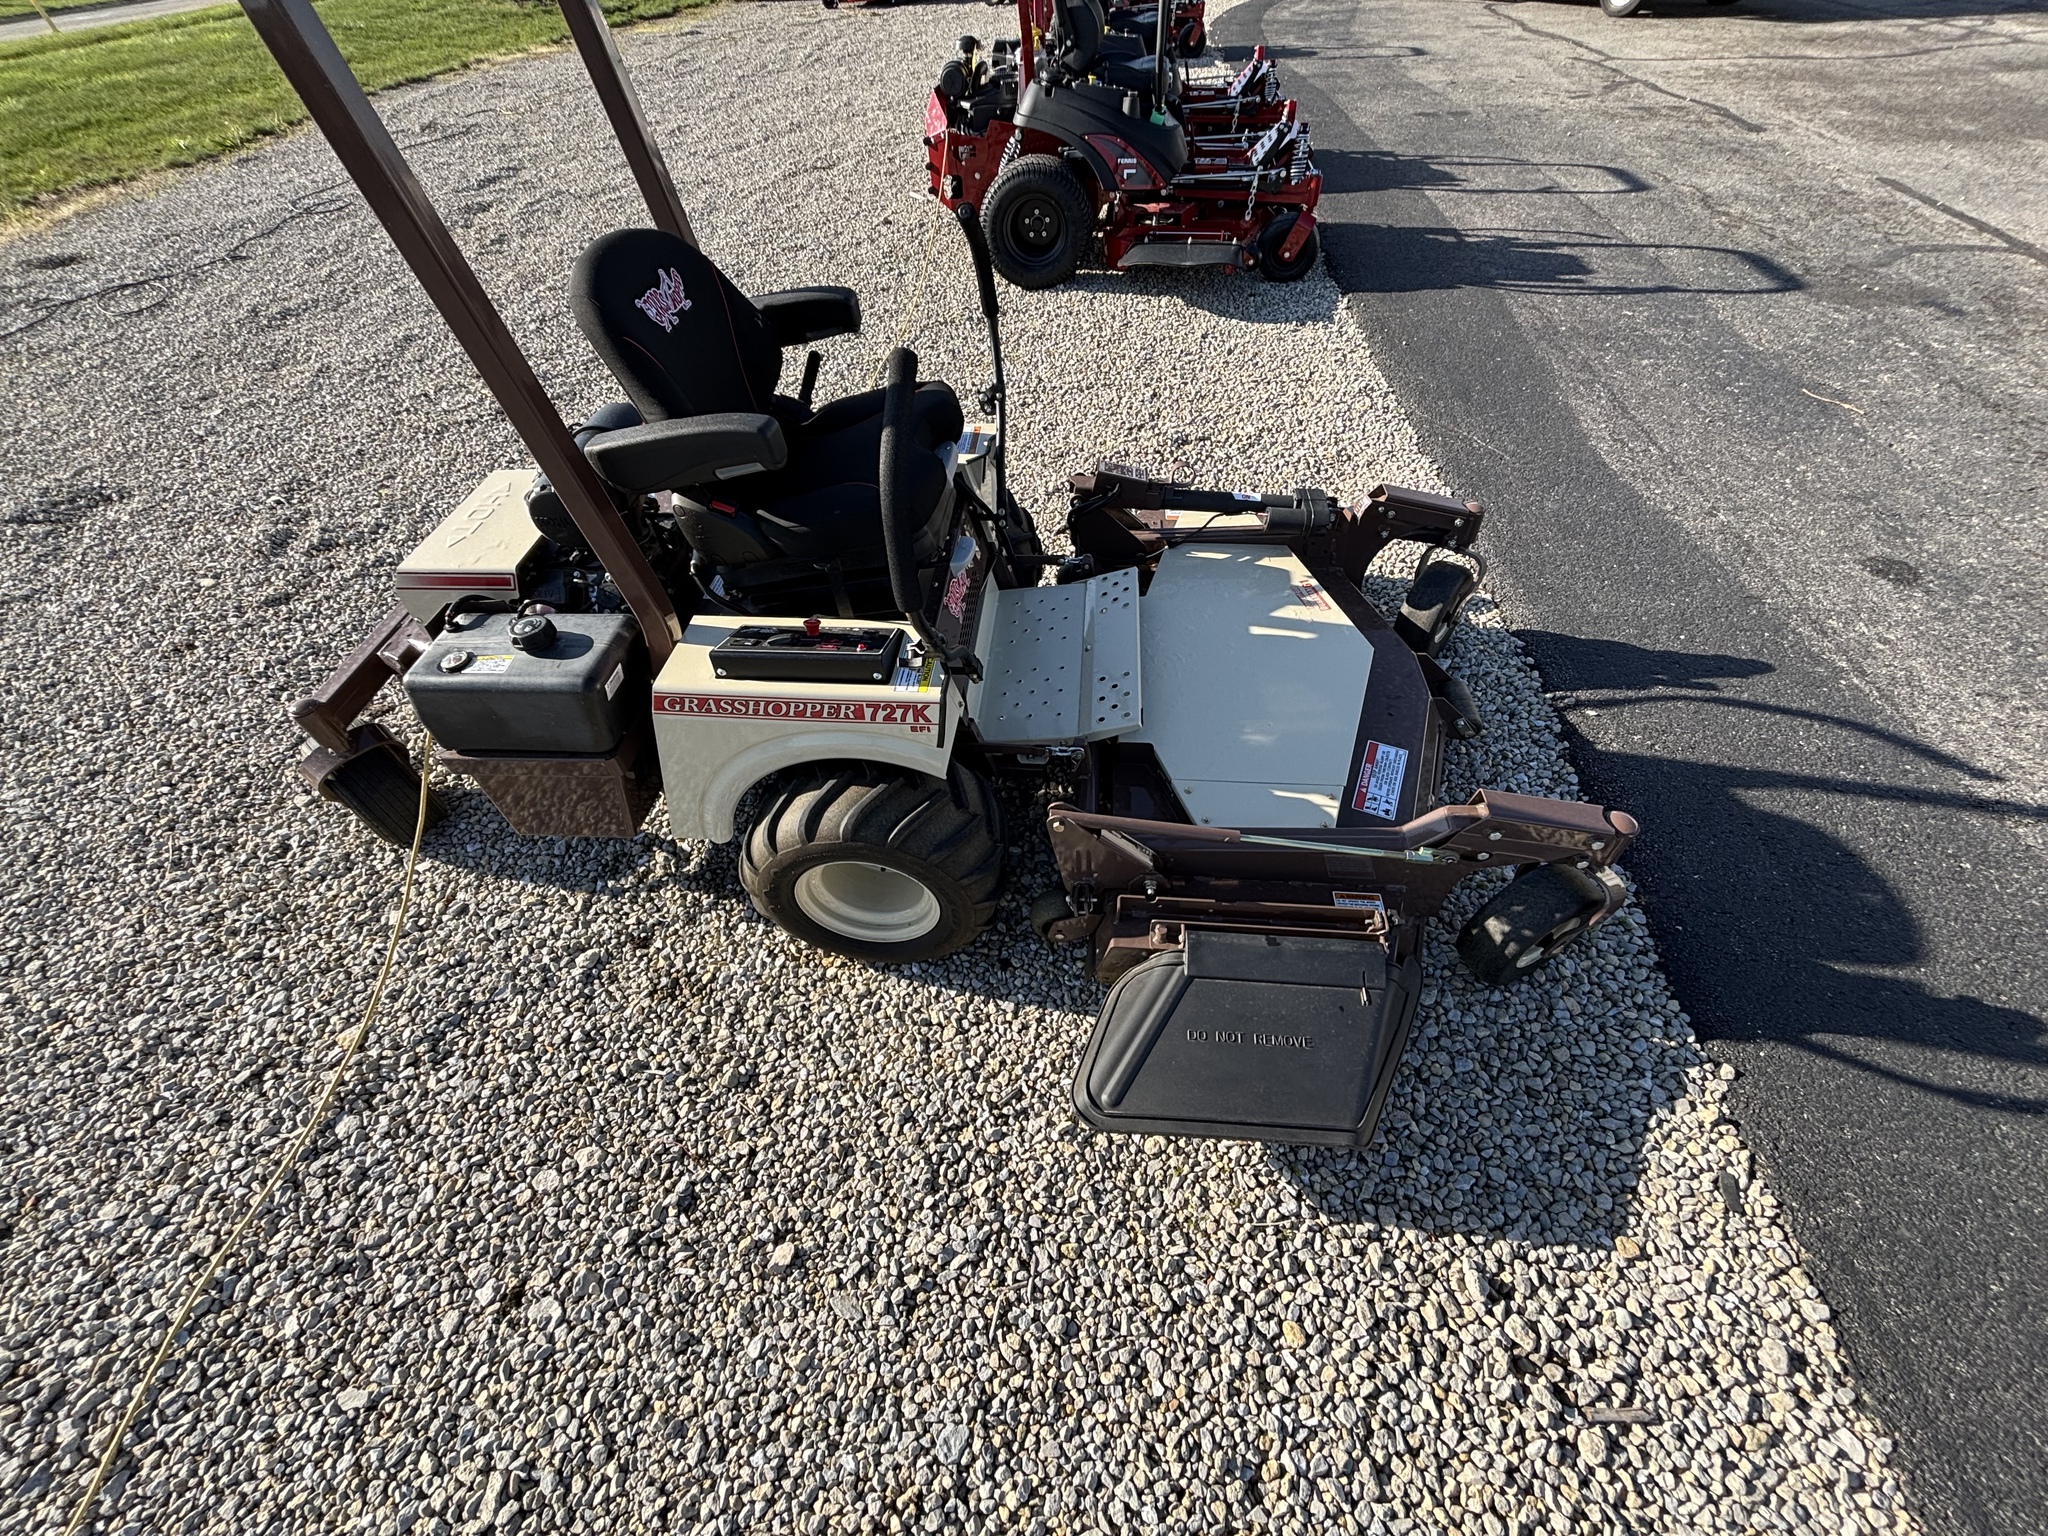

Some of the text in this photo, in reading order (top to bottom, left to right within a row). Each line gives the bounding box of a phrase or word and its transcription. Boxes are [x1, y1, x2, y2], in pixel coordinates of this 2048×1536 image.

[663, 696, 932, 723] GRASSHOPPER 727K
[909, 725, 932, 734] EFI
[1361, 763, 1372, 785] DANGER
[1186, 1029, 1315, 1049] DO NOT REMOVE
